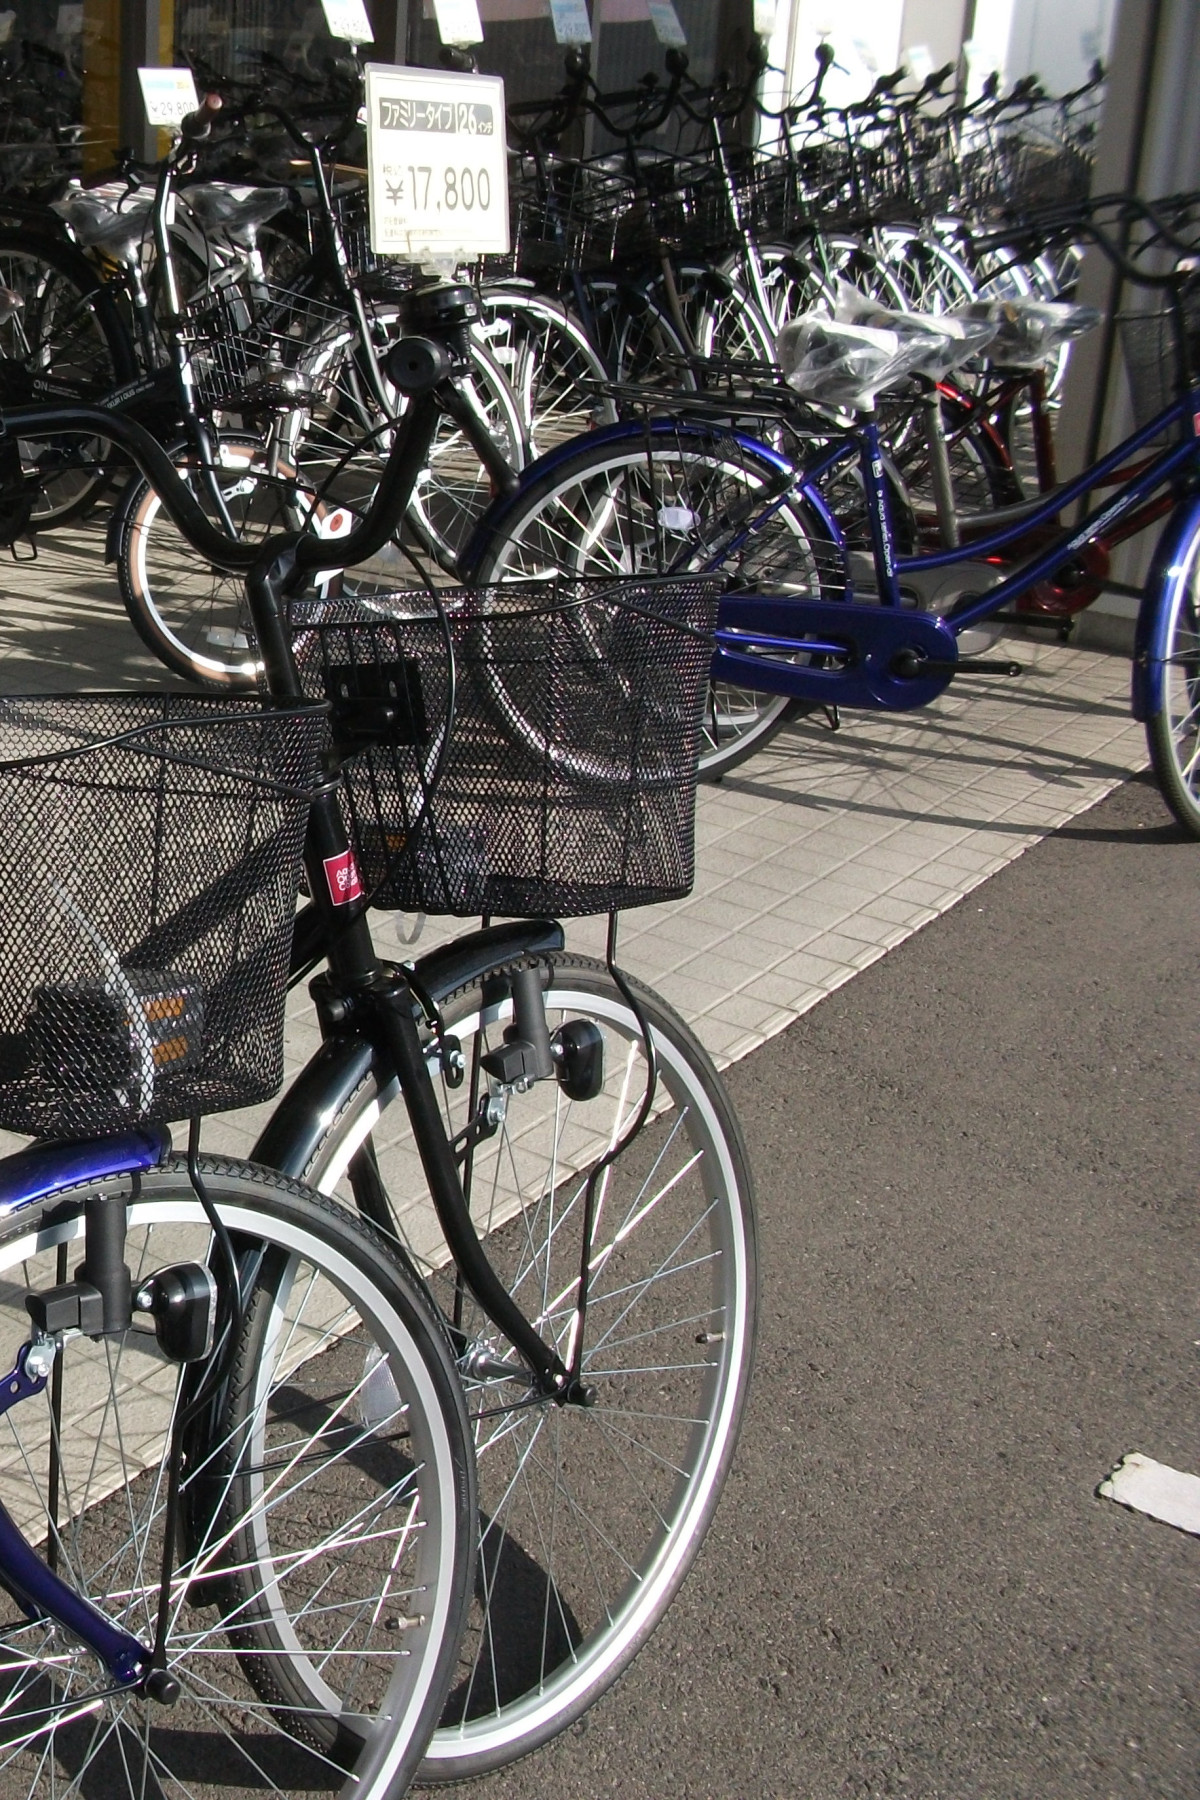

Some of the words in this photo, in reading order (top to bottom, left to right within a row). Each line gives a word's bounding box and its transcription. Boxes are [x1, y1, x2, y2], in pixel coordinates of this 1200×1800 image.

[381, 99, 452, 130] ファミリータイプ
[385, 165, 491, 213] ¥17,800
